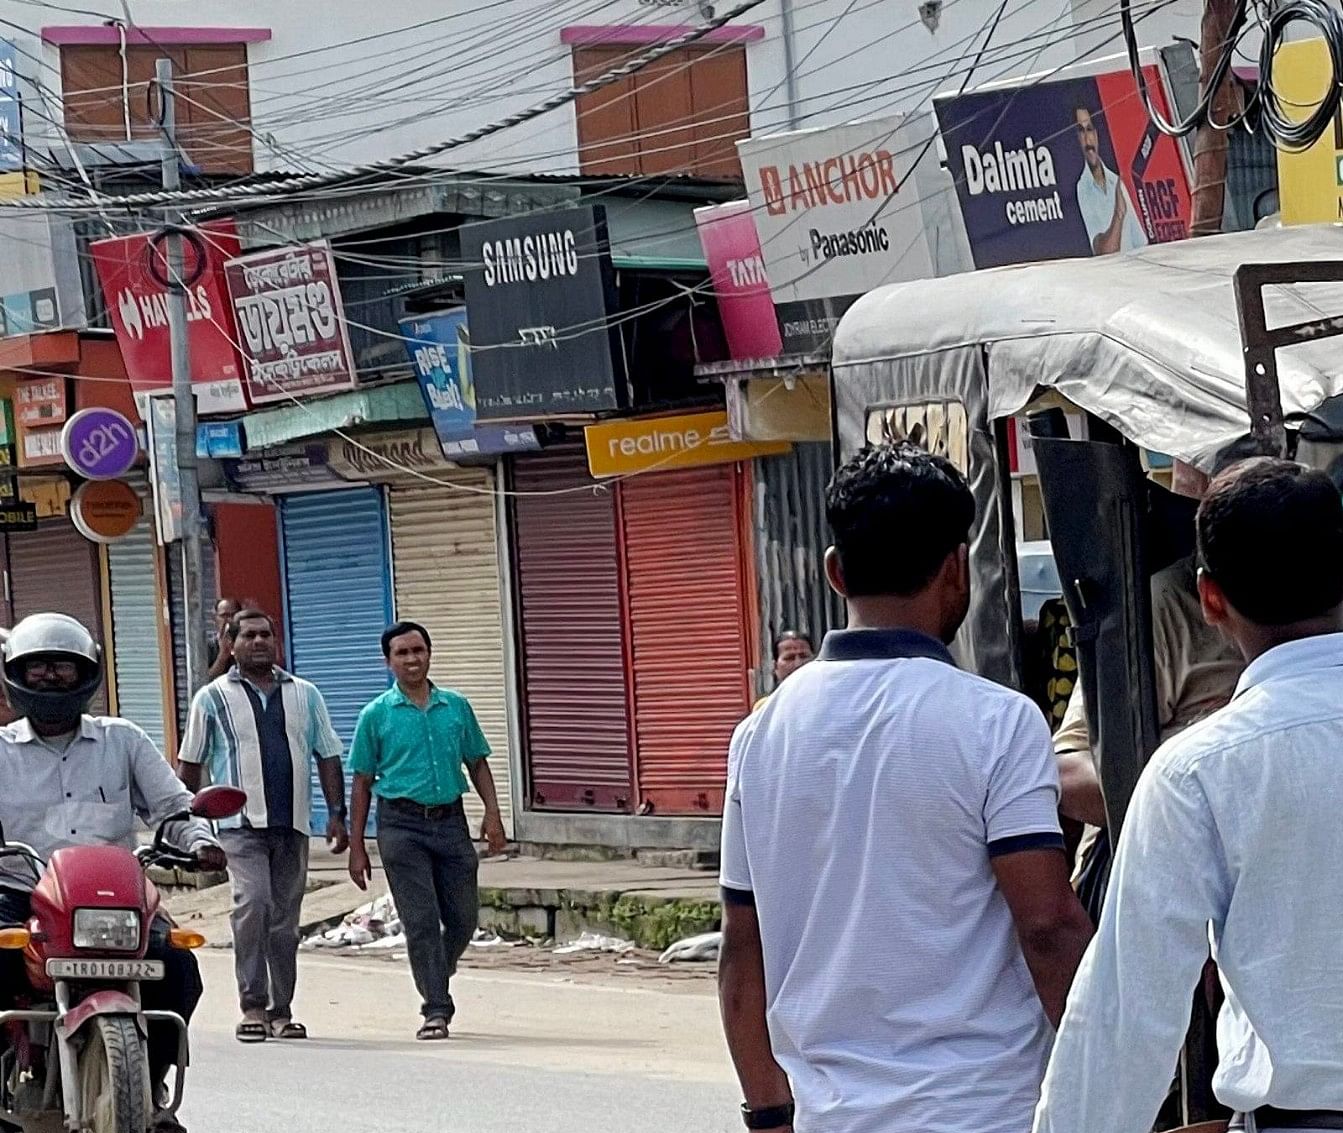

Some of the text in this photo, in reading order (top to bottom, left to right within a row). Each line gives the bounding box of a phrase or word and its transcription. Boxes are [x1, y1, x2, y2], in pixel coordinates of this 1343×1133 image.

[788, 149, 899, 210] ANCHOR
[961, 137, 1057, 195] Dalmia
[1005, 192, 1064, 225] cement
[482, 229, 578, 287] SAMSUNG
[809, 219, 889, 260] Panasonic
[727, 256, 768, 287] TATA
[138, 284, 213, 329] HAVLS
[78, 422, 129, 468] d2h
[608, 429, 700, 458] realme
